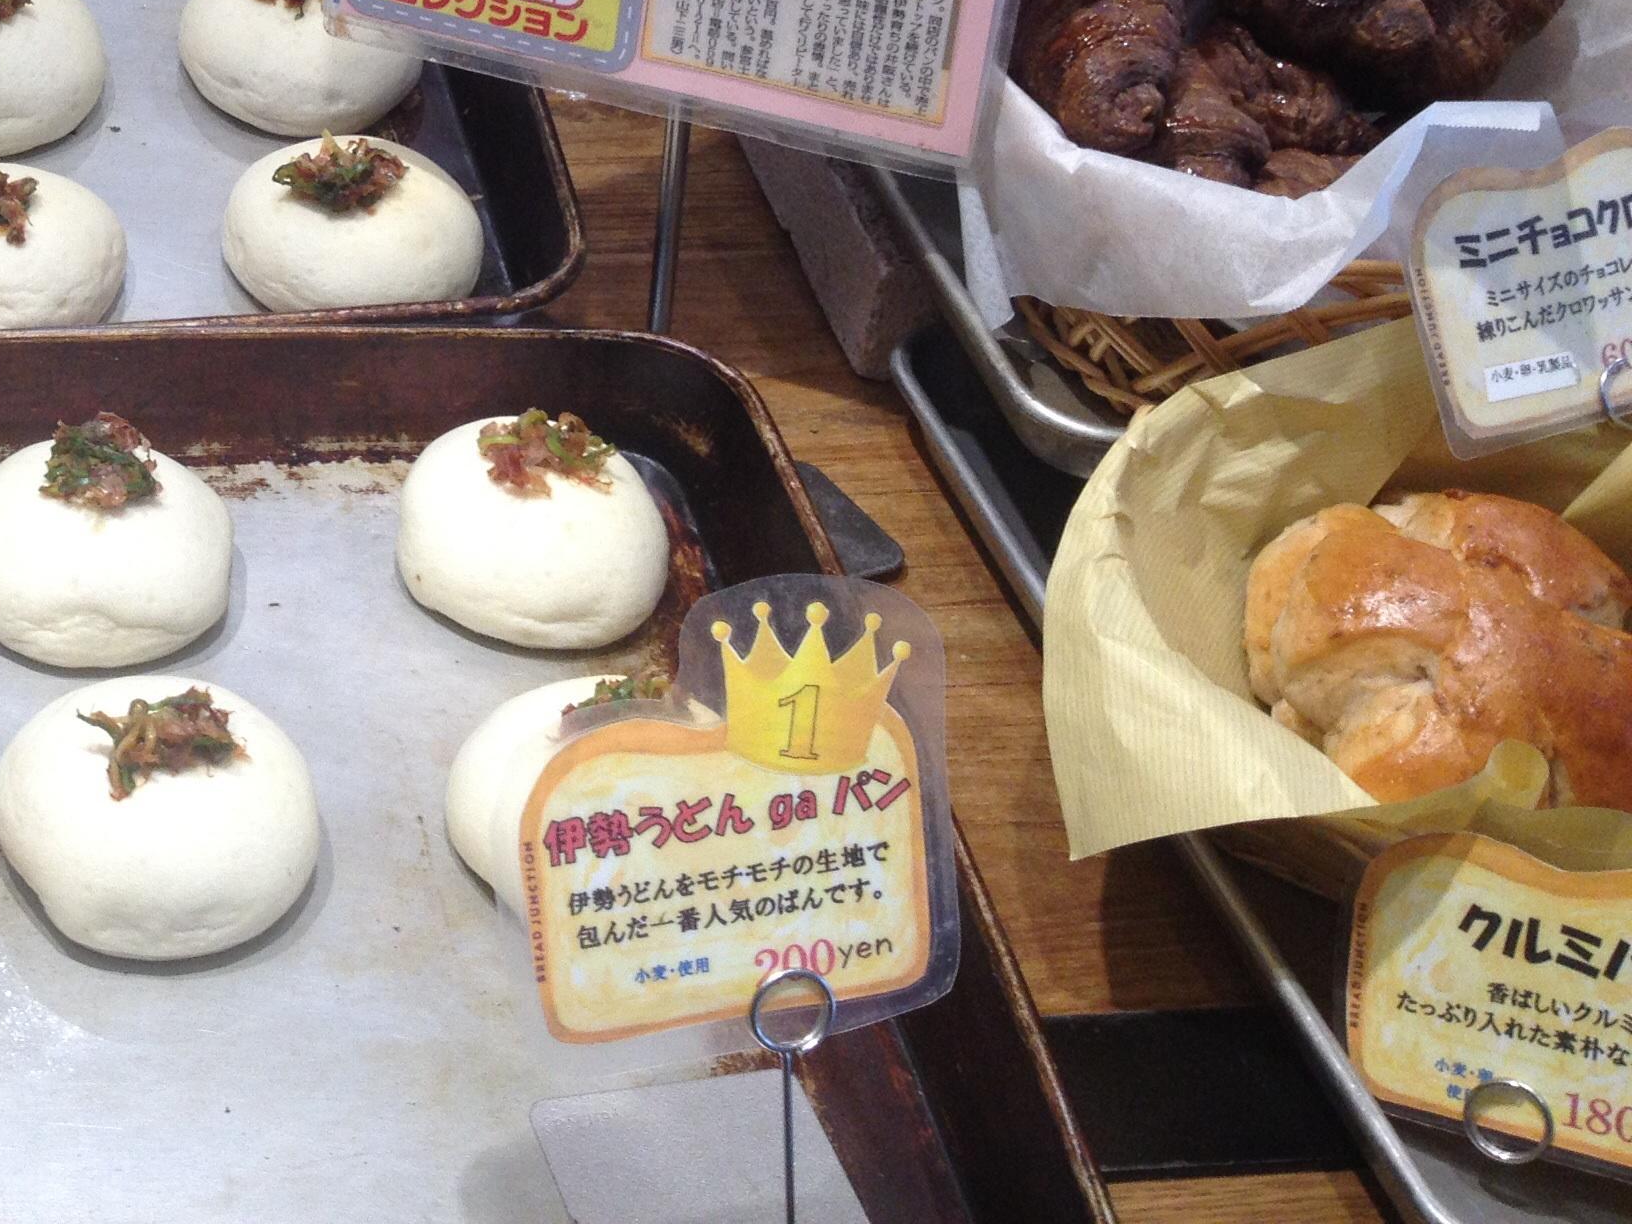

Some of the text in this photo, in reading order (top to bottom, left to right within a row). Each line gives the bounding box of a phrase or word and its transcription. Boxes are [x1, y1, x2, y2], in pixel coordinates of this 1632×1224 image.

[778, 683, 820, 761] 1
[768, 788, 819, 829] ga
[832, 769, 911, 816] パン
[568, 840, 890, 917] 伊勢うどんをモチモチの生地で
